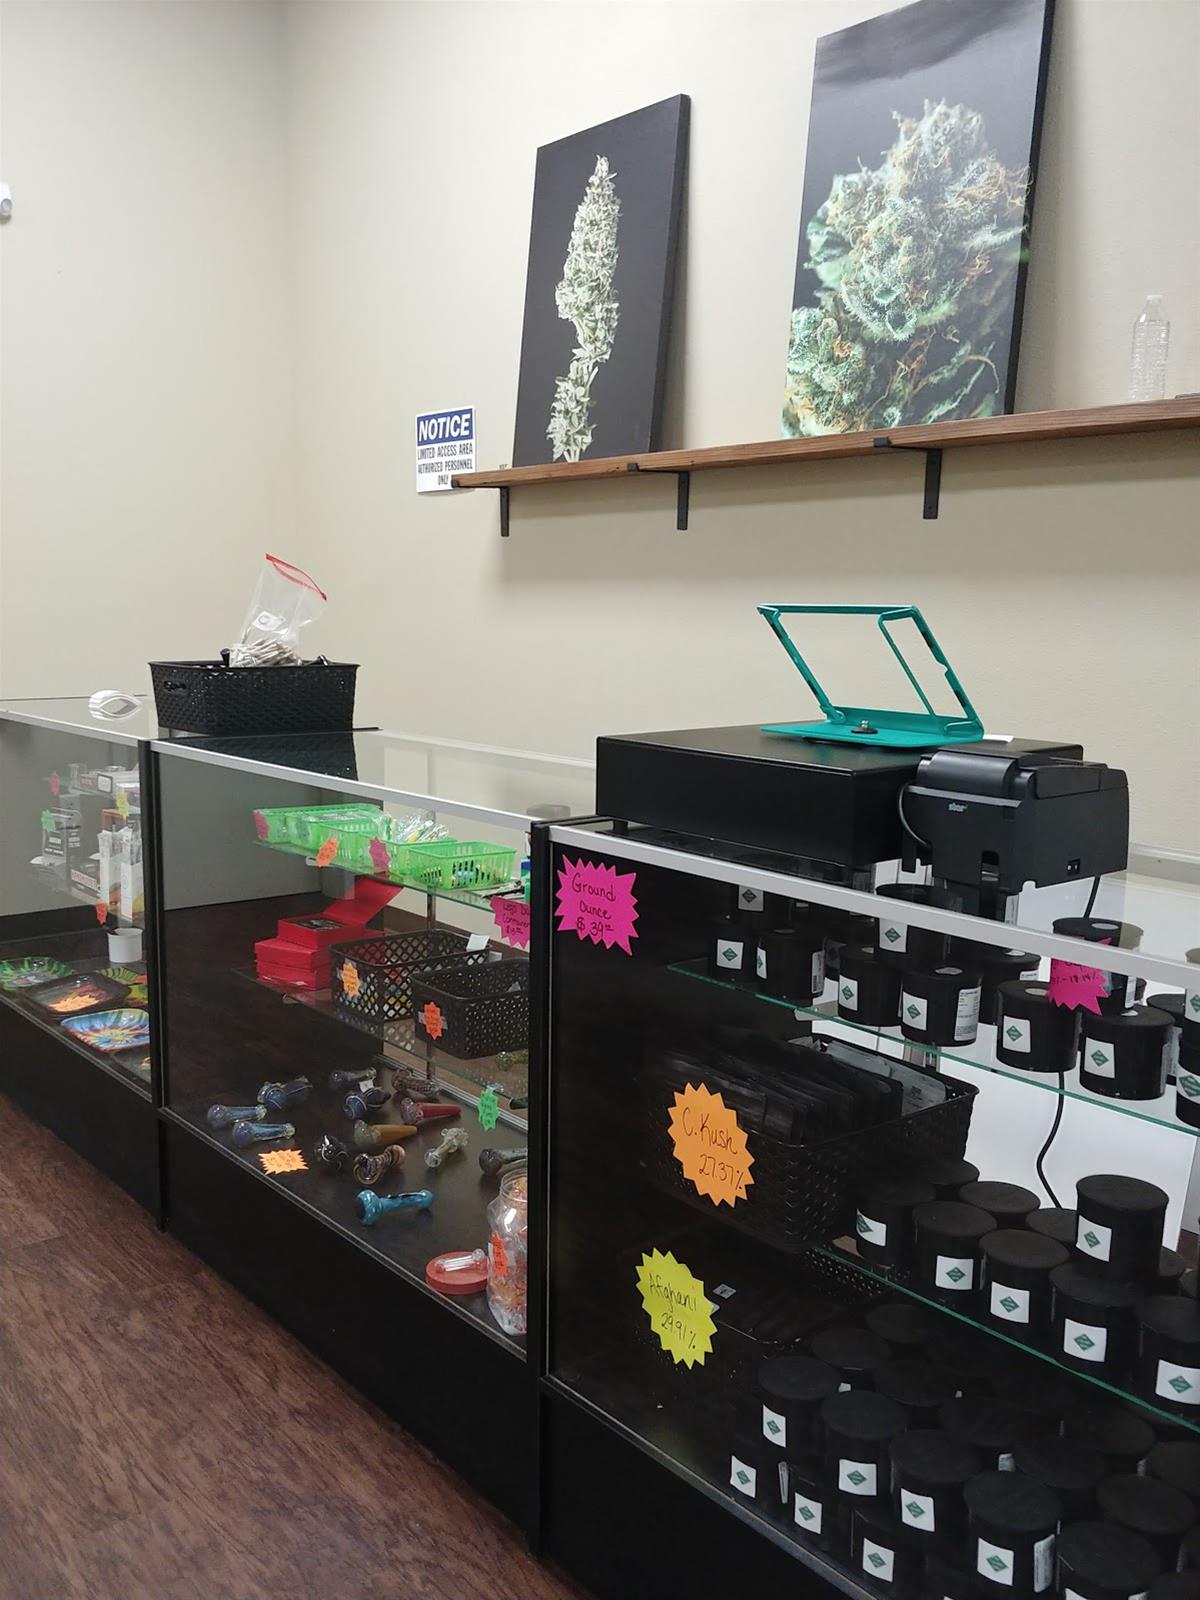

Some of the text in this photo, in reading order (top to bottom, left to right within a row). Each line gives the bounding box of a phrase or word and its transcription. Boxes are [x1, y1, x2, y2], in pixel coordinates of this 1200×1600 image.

[419, 413, 471, 441] NOTICE
[417, 442, 473, 460] LIMITED ACCESS AREA
[445, 458, 473, 471] PERSONNEL
[438, 474, 449, 485] ONLY
[572, 872, 616, 902] Ground
[580, 900, 612, 919] Ounce
[649, 1272, 697, 1313] Afghani
